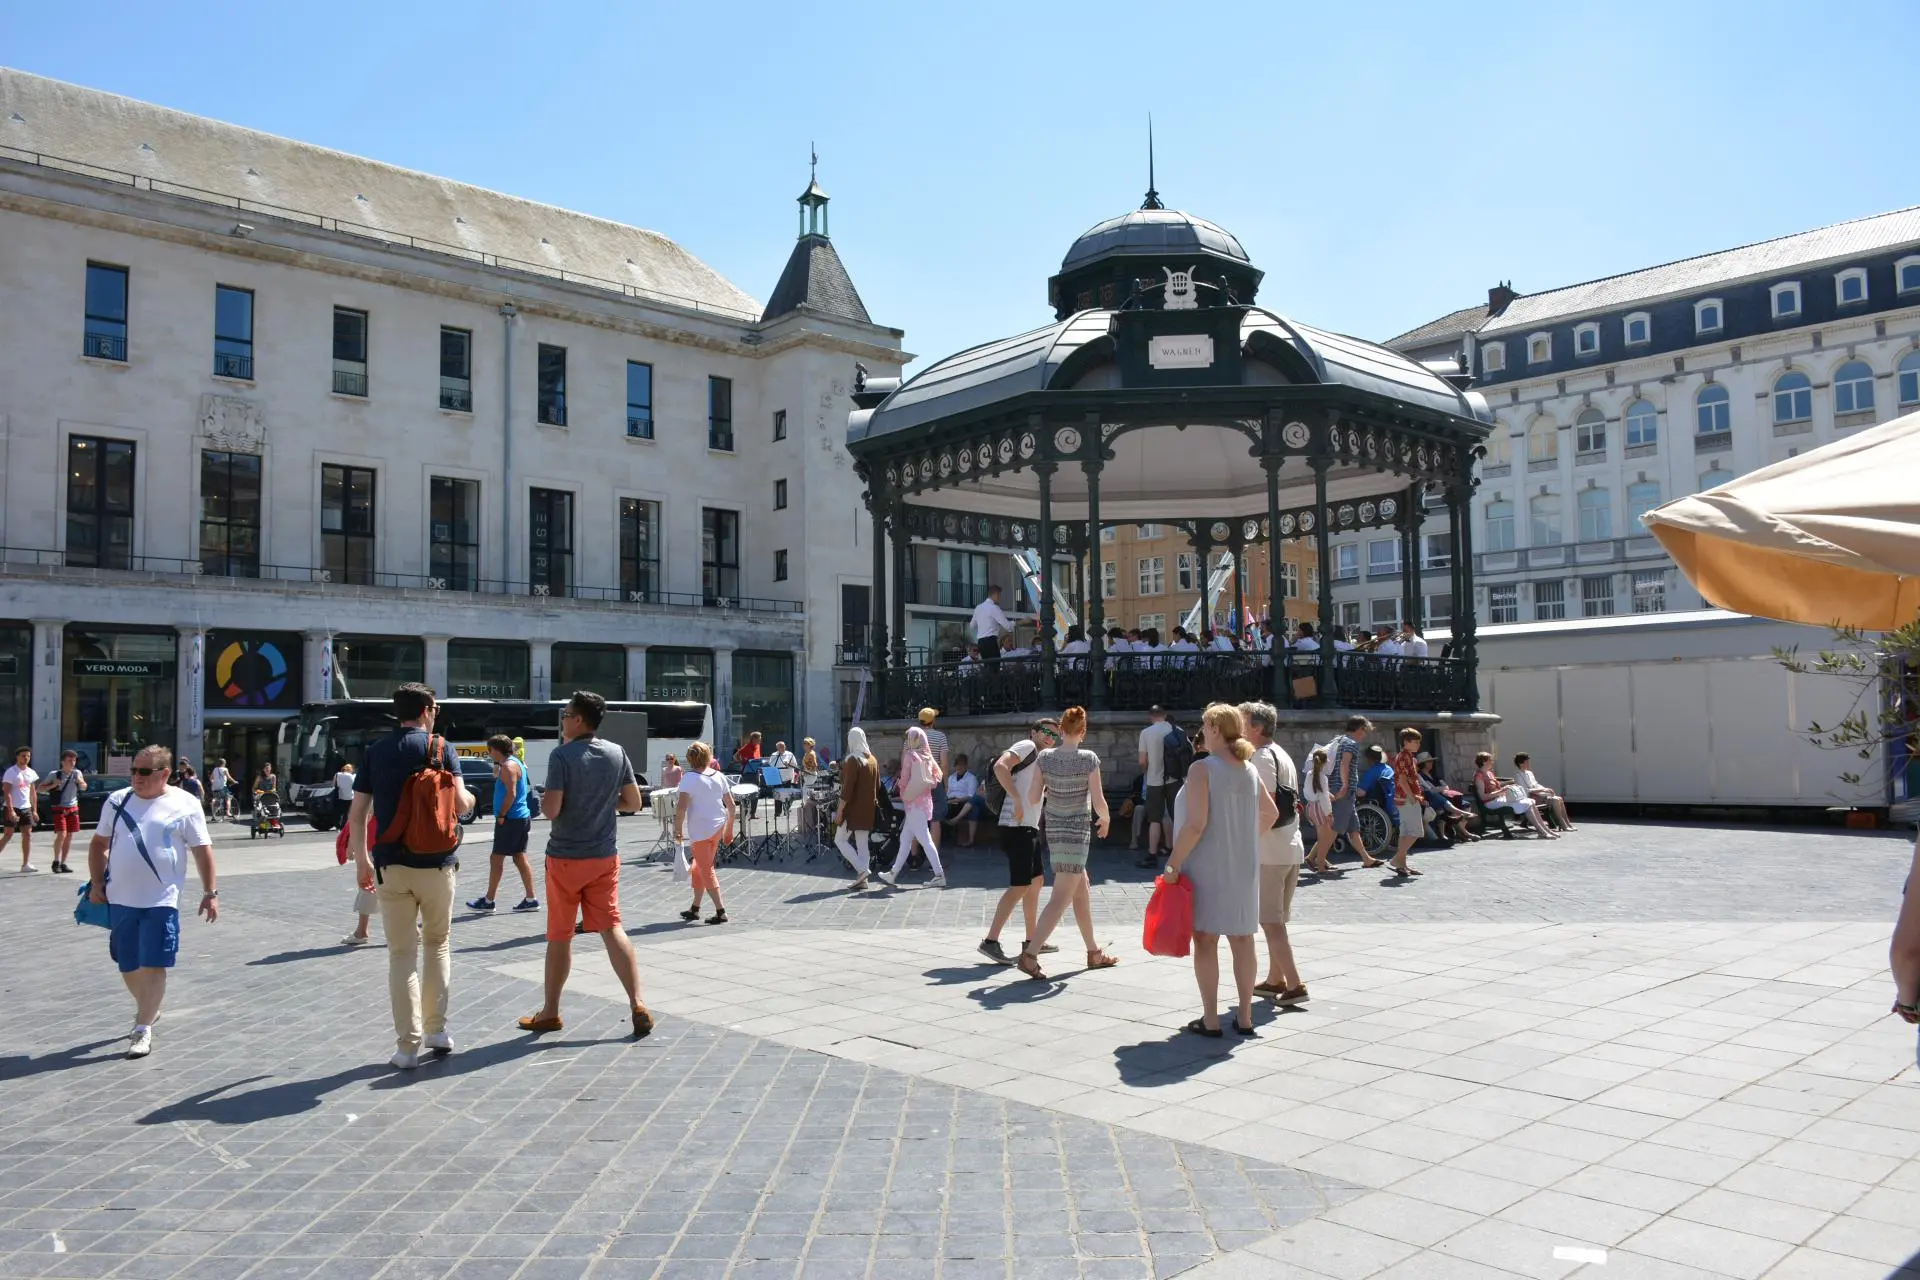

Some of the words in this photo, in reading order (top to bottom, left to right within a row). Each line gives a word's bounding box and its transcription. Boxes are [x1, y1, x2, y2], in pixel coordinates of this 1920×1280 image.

[85, 664, 115, 672] VERO
[117, 665, 149, 673] MODA
[457, 684, 515, 695] ESPRIT
[653, 687, 703, 697] ESPRIT
